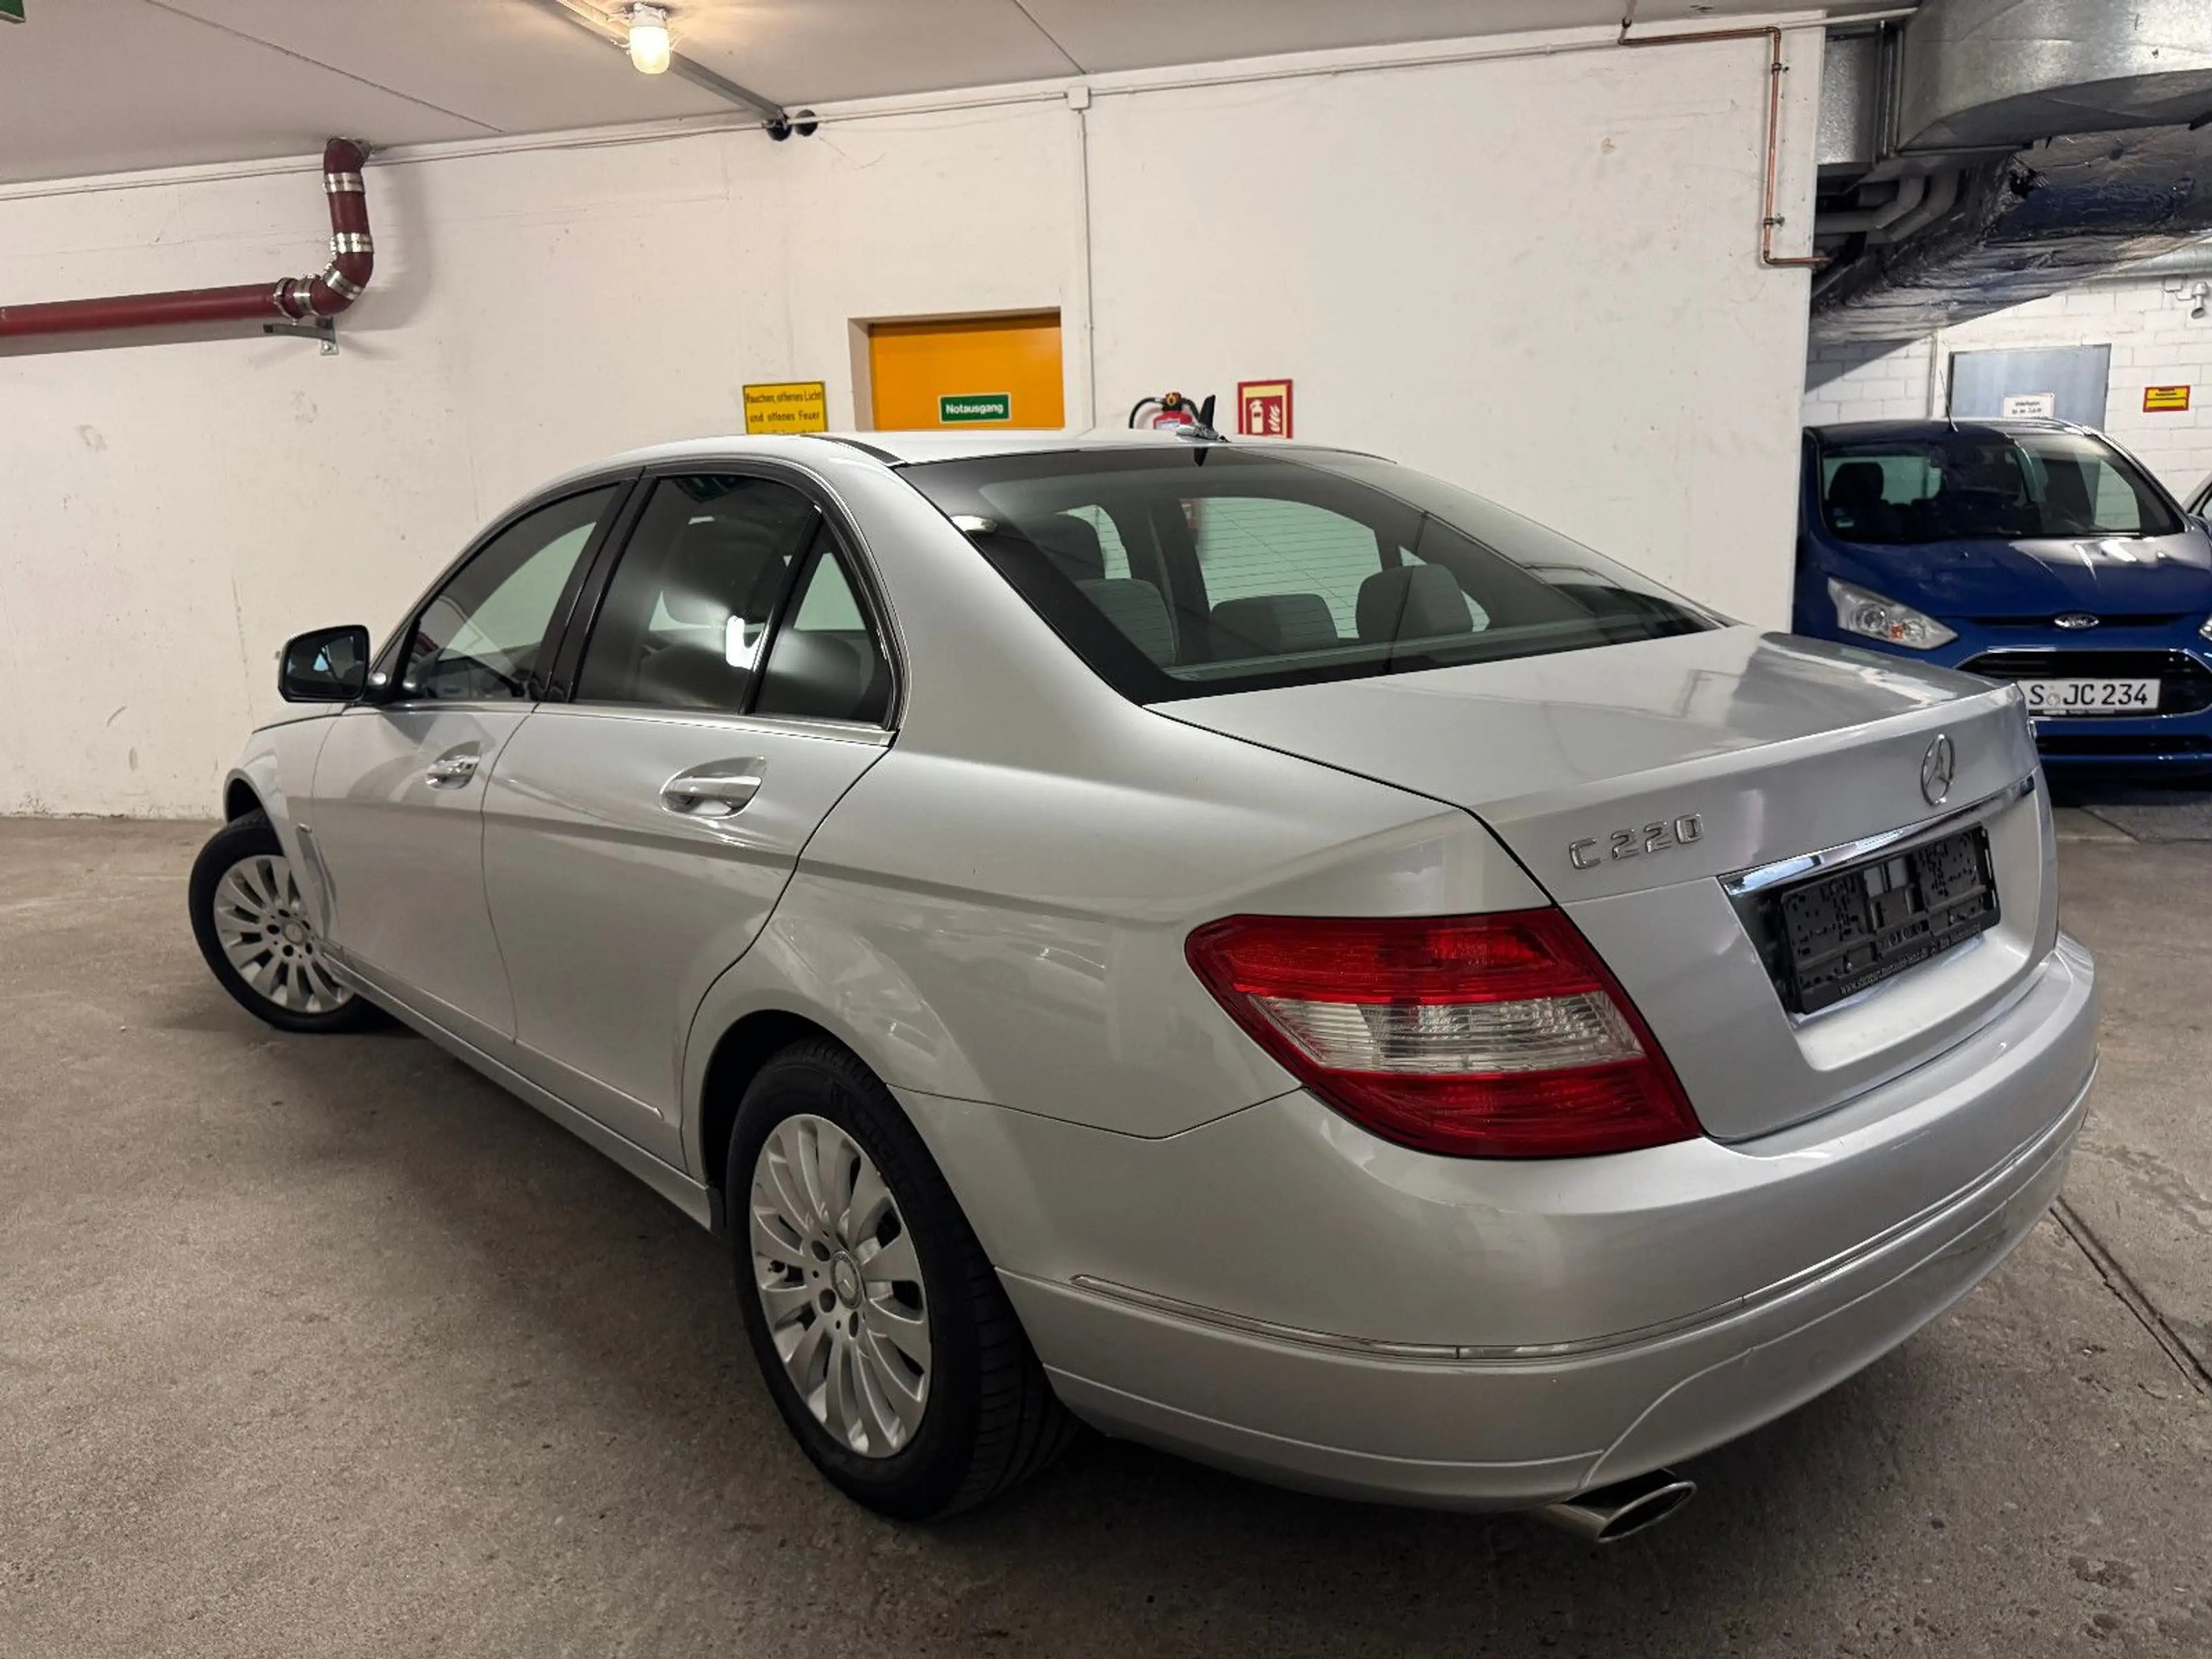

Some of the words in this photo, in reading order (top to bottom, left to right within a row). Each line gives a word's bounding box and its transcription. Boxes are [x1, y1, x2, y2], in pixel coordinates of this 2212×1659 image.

[945, 403, 1004, 415] Notausgang
[2029, 684, 2045, 705] S
[2063, 684, 2095, 705] JC
[2101, 683, 2148, 705] 234
[1569, 838, 1603, 869] C
[1611, 813, 1704, 861] 220
